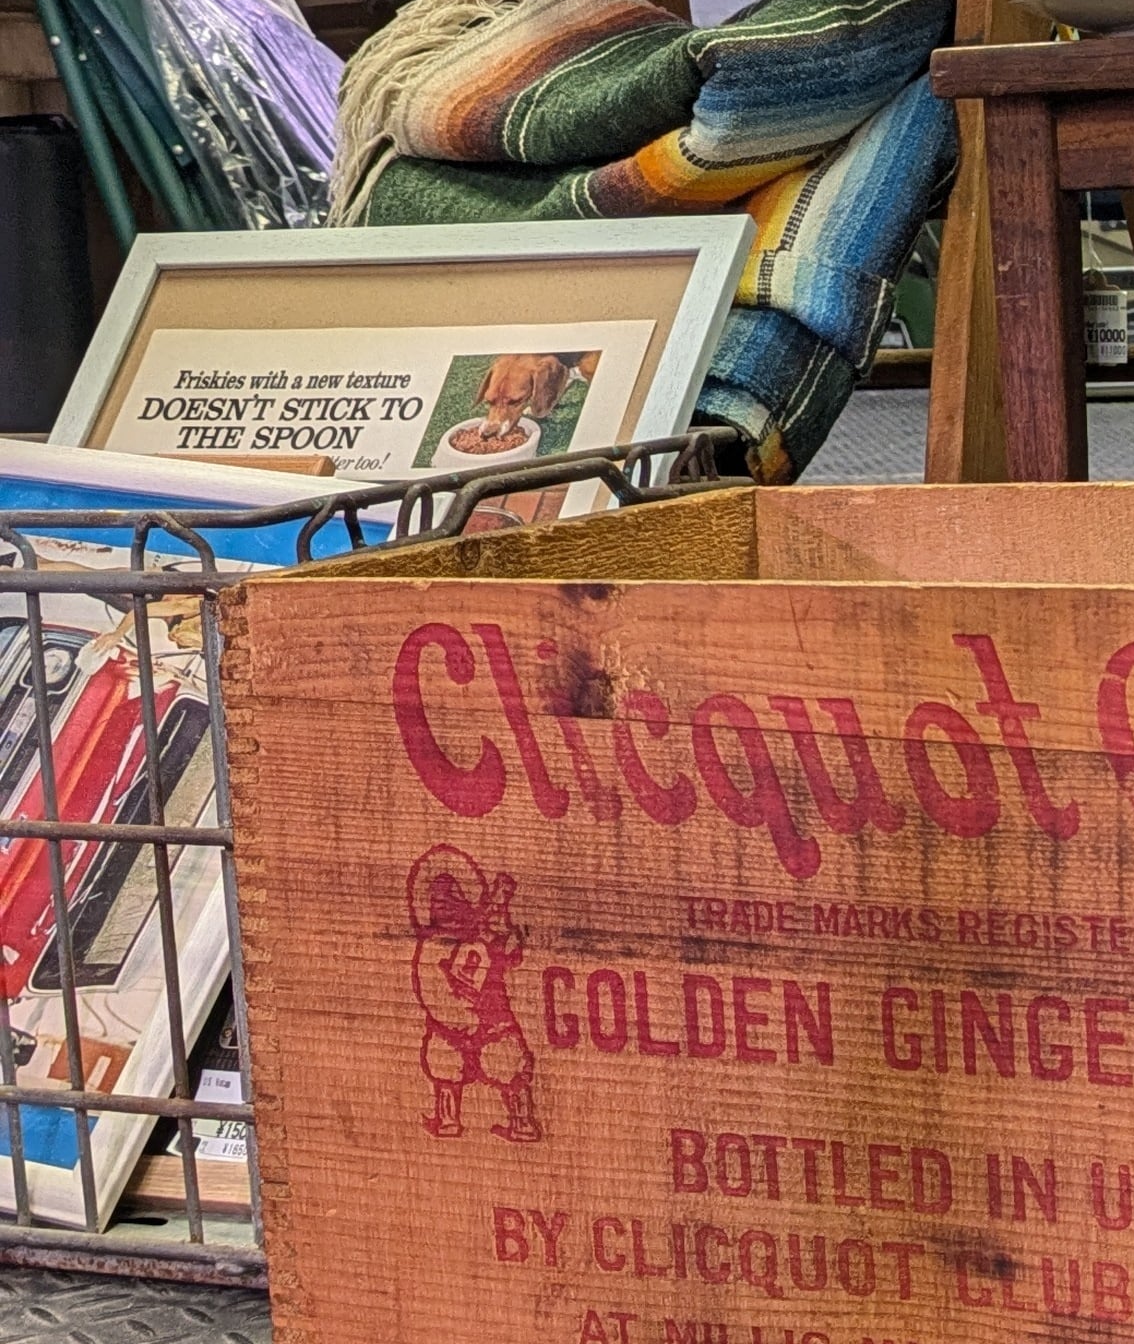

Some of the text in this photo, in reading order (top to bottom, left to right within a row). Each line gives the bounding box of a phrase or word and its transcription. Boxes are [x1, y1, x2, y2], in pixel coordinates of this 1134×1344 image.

[1087, 328, 1126, 343] ¥10000
[174, 370, 411, 389] Friskies with a new texture
[137, 393, 424, 421] DOESN'T STICK TO
[176, 426, 364, 449] THE SPOON
[354, 452, 391, 471] too!
[392, 622, 1080, 879] Clicquot
[678, 895, 799, 935] TRADE
[813, 902, 943, 943] MARKS
[542, 966, 834, 1067] GOLDEN
[670, 1128, 954, 1215] BOTTLED
[986, 1155, 1057, 1224] IN
[492, 1206, 571, 1267] BY
[592, 1216, 925, 1300] CLICQUOT
[955, 1250, 1133, 1323] CLUB
